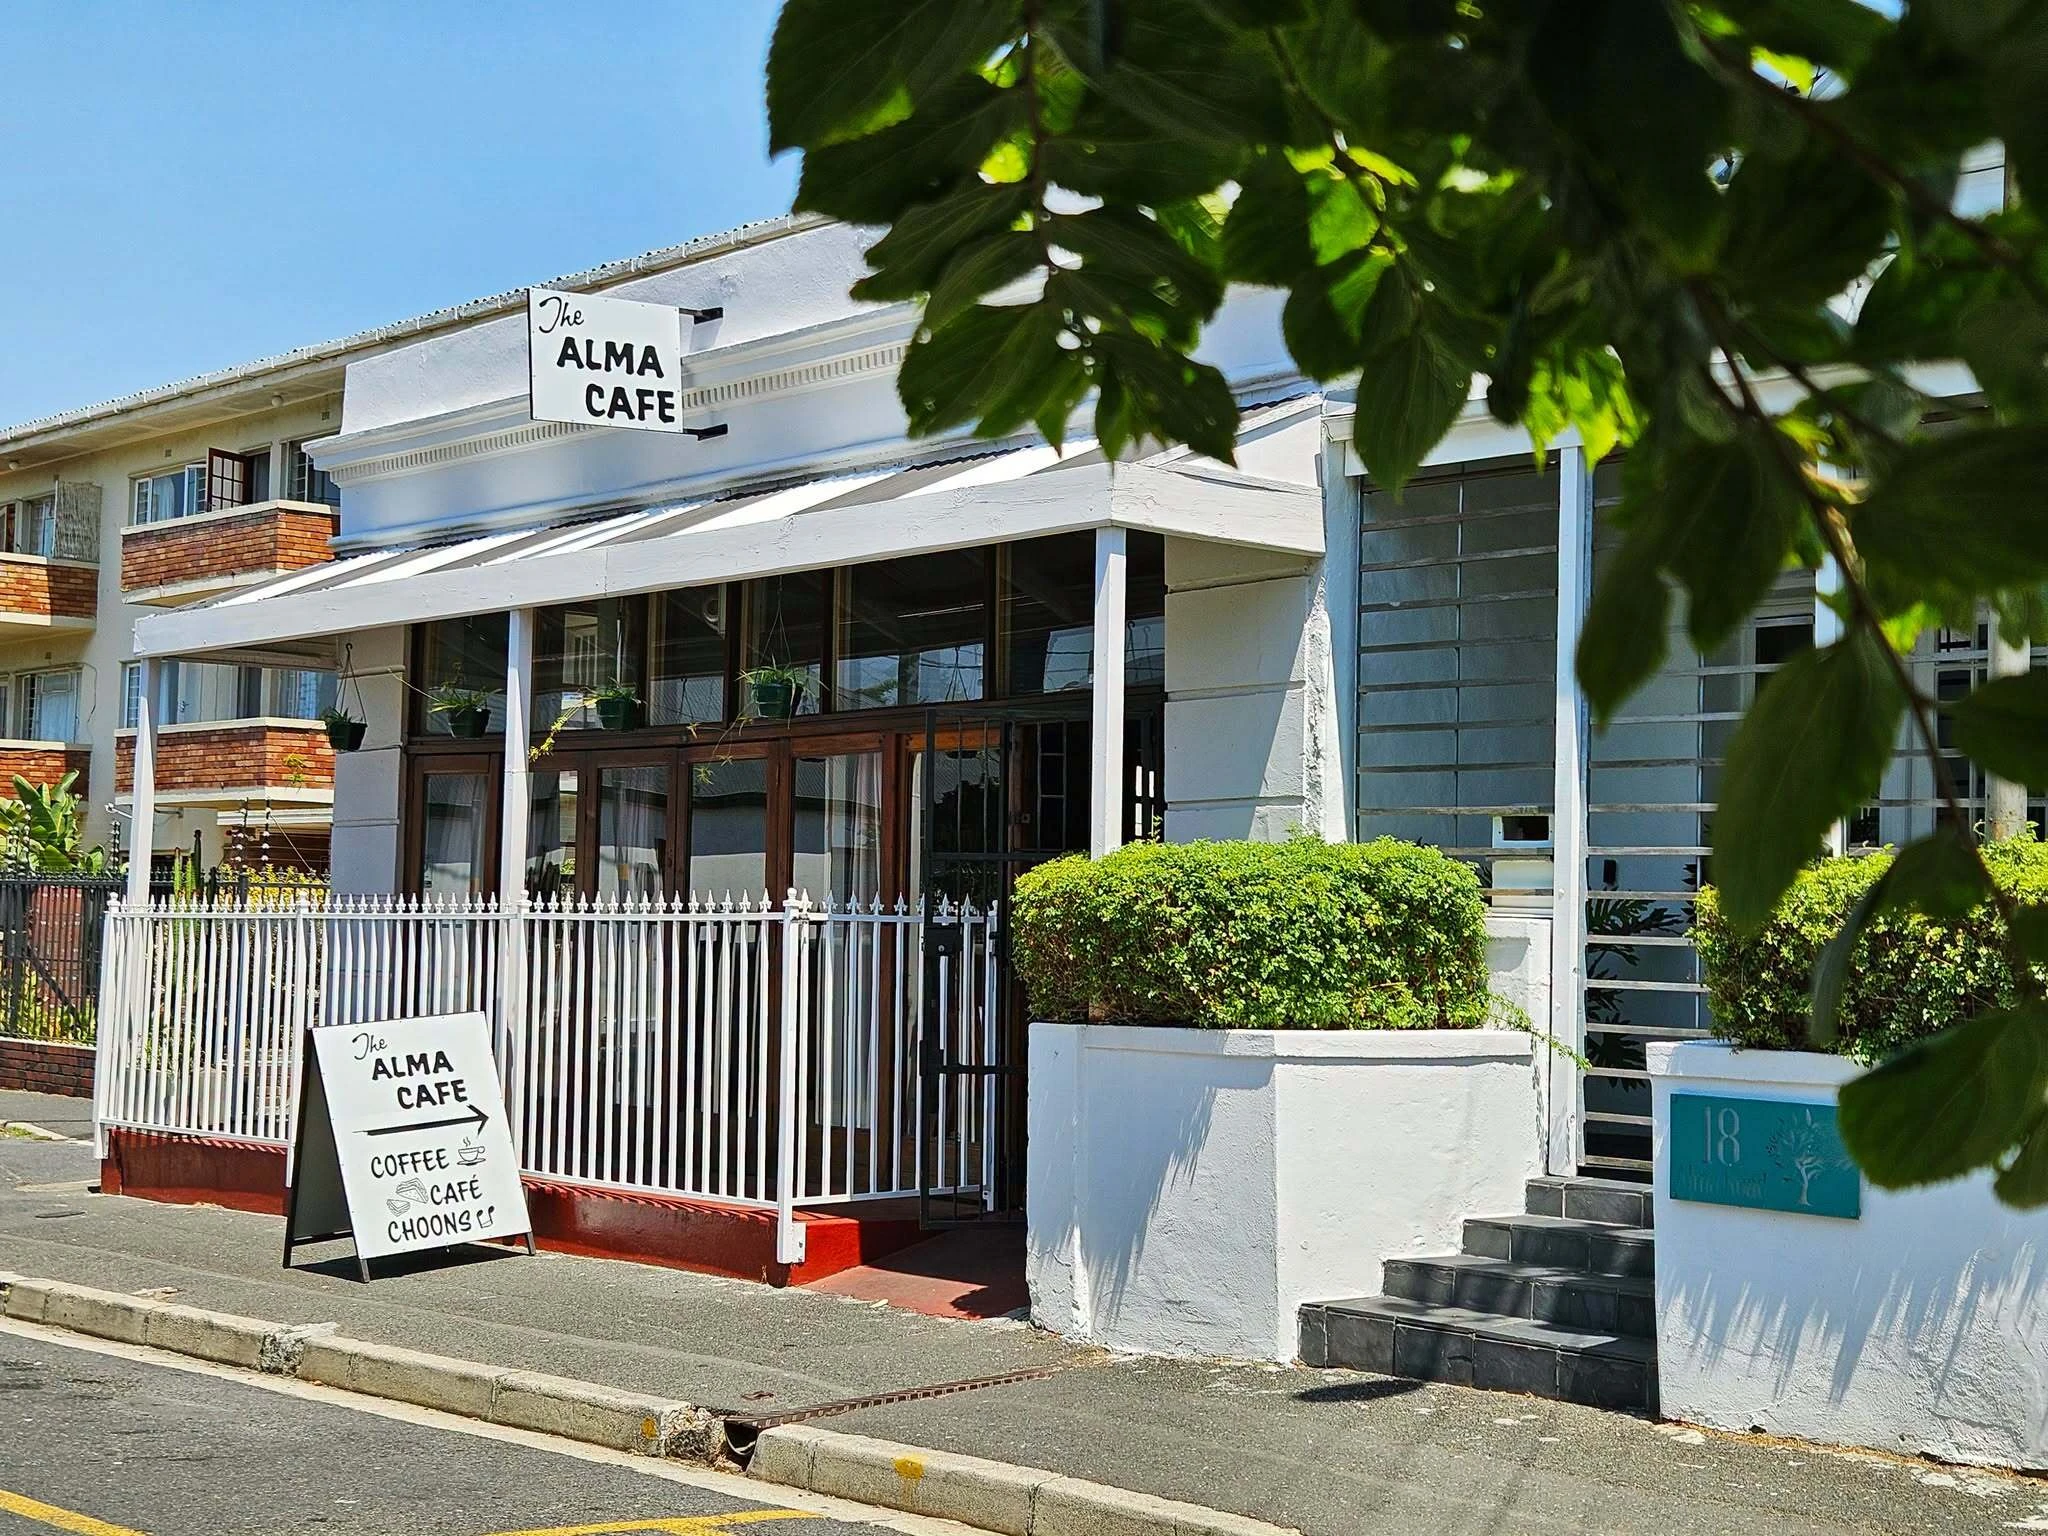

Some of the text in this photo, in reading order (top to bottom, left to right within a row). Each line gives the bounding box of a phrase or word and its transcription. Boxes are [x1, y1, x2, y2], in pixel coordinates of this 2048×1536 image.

[539, 296, 584, 334] The
[556, 336, 665, 379] ALMA
[585, 383, 676, 423] CAFE
[352, 1032, 388, 1060] The
[371, 1050, 455, 1081] ALMA
[396, 1078, 469, 1110] CAFE
[1703, 1105, 1741, 1167] 18
[370, 1148, 450, 1178] COFFEE
[430, 1174, 483, 1206] CAFÉ
[387, 1209, 472, 1243] CHOONS
